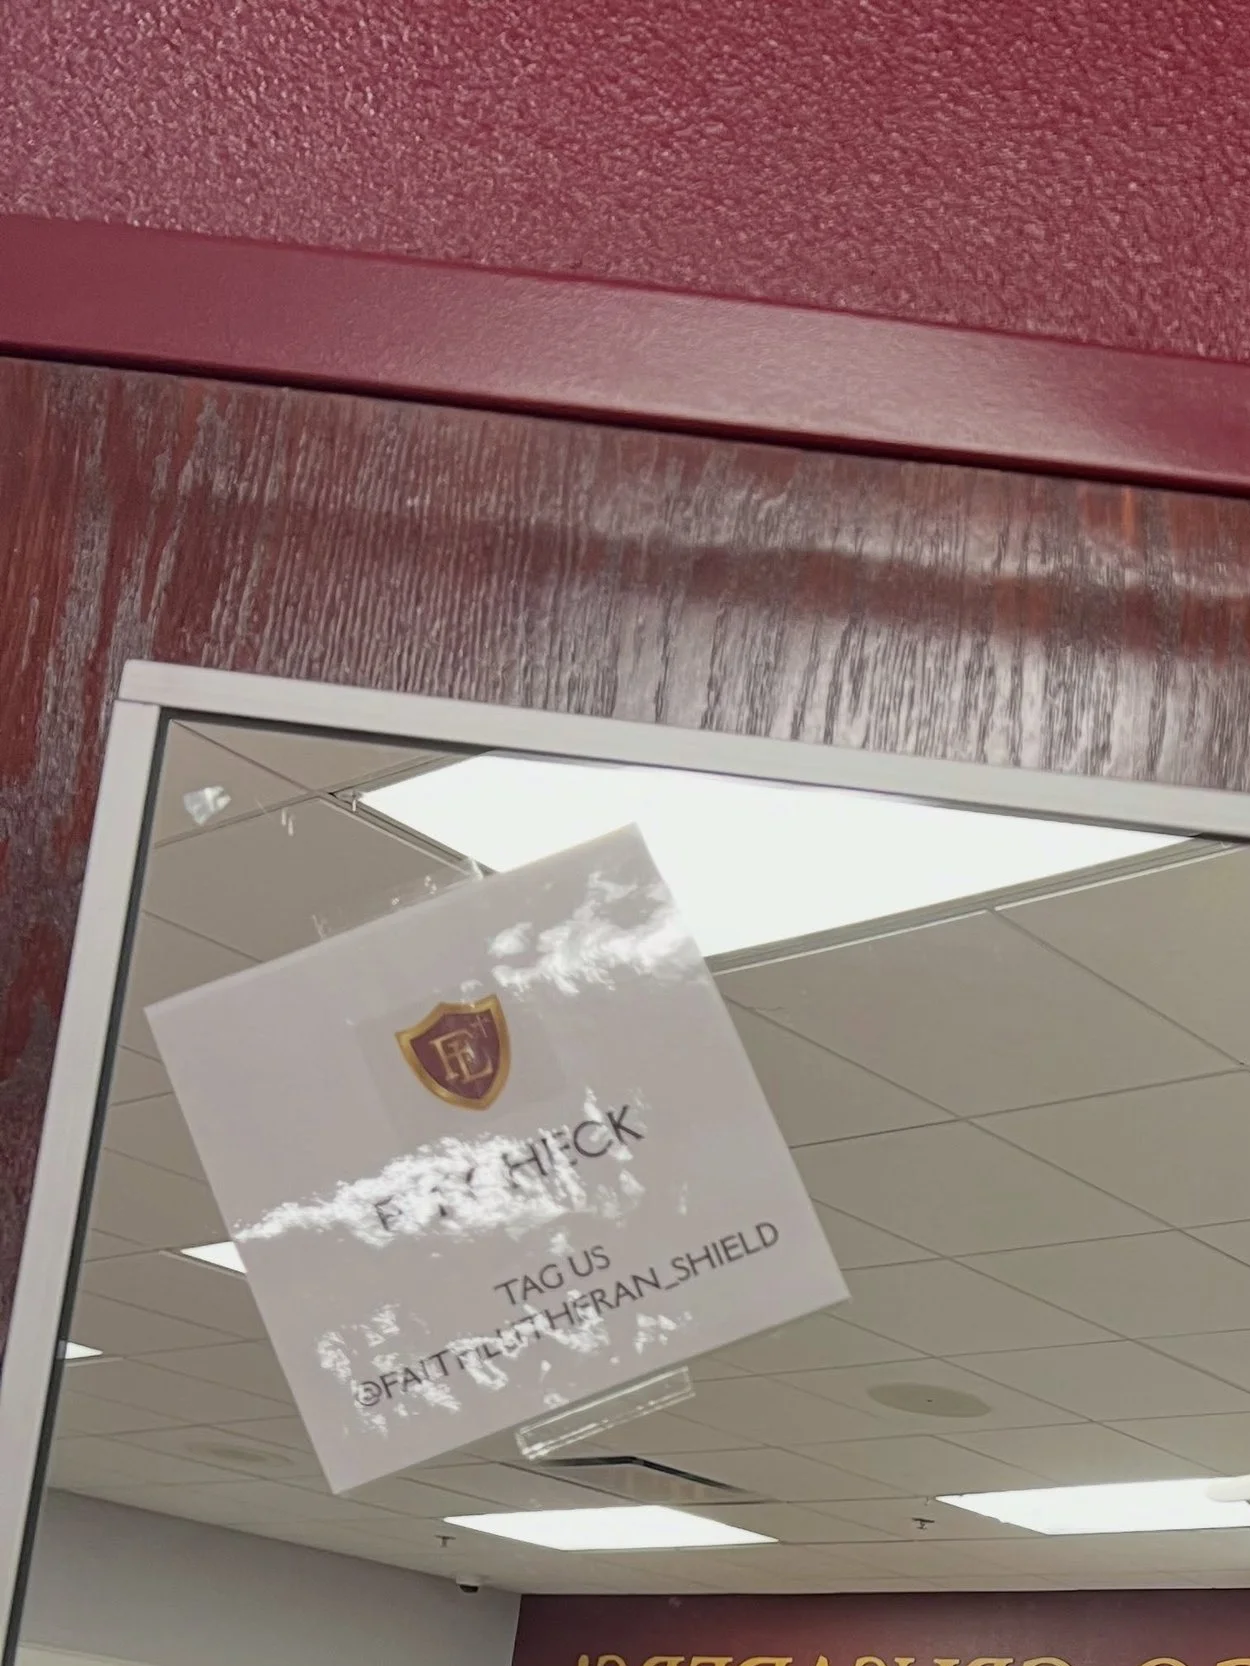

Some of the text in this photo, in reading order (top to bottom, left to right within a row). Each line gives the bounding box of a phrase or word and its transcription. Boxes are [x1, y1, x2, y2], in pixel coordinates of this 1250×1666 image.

[464, 1104, 645, 1197] HECK
[494, 1245, 611, 1306] TAG US
